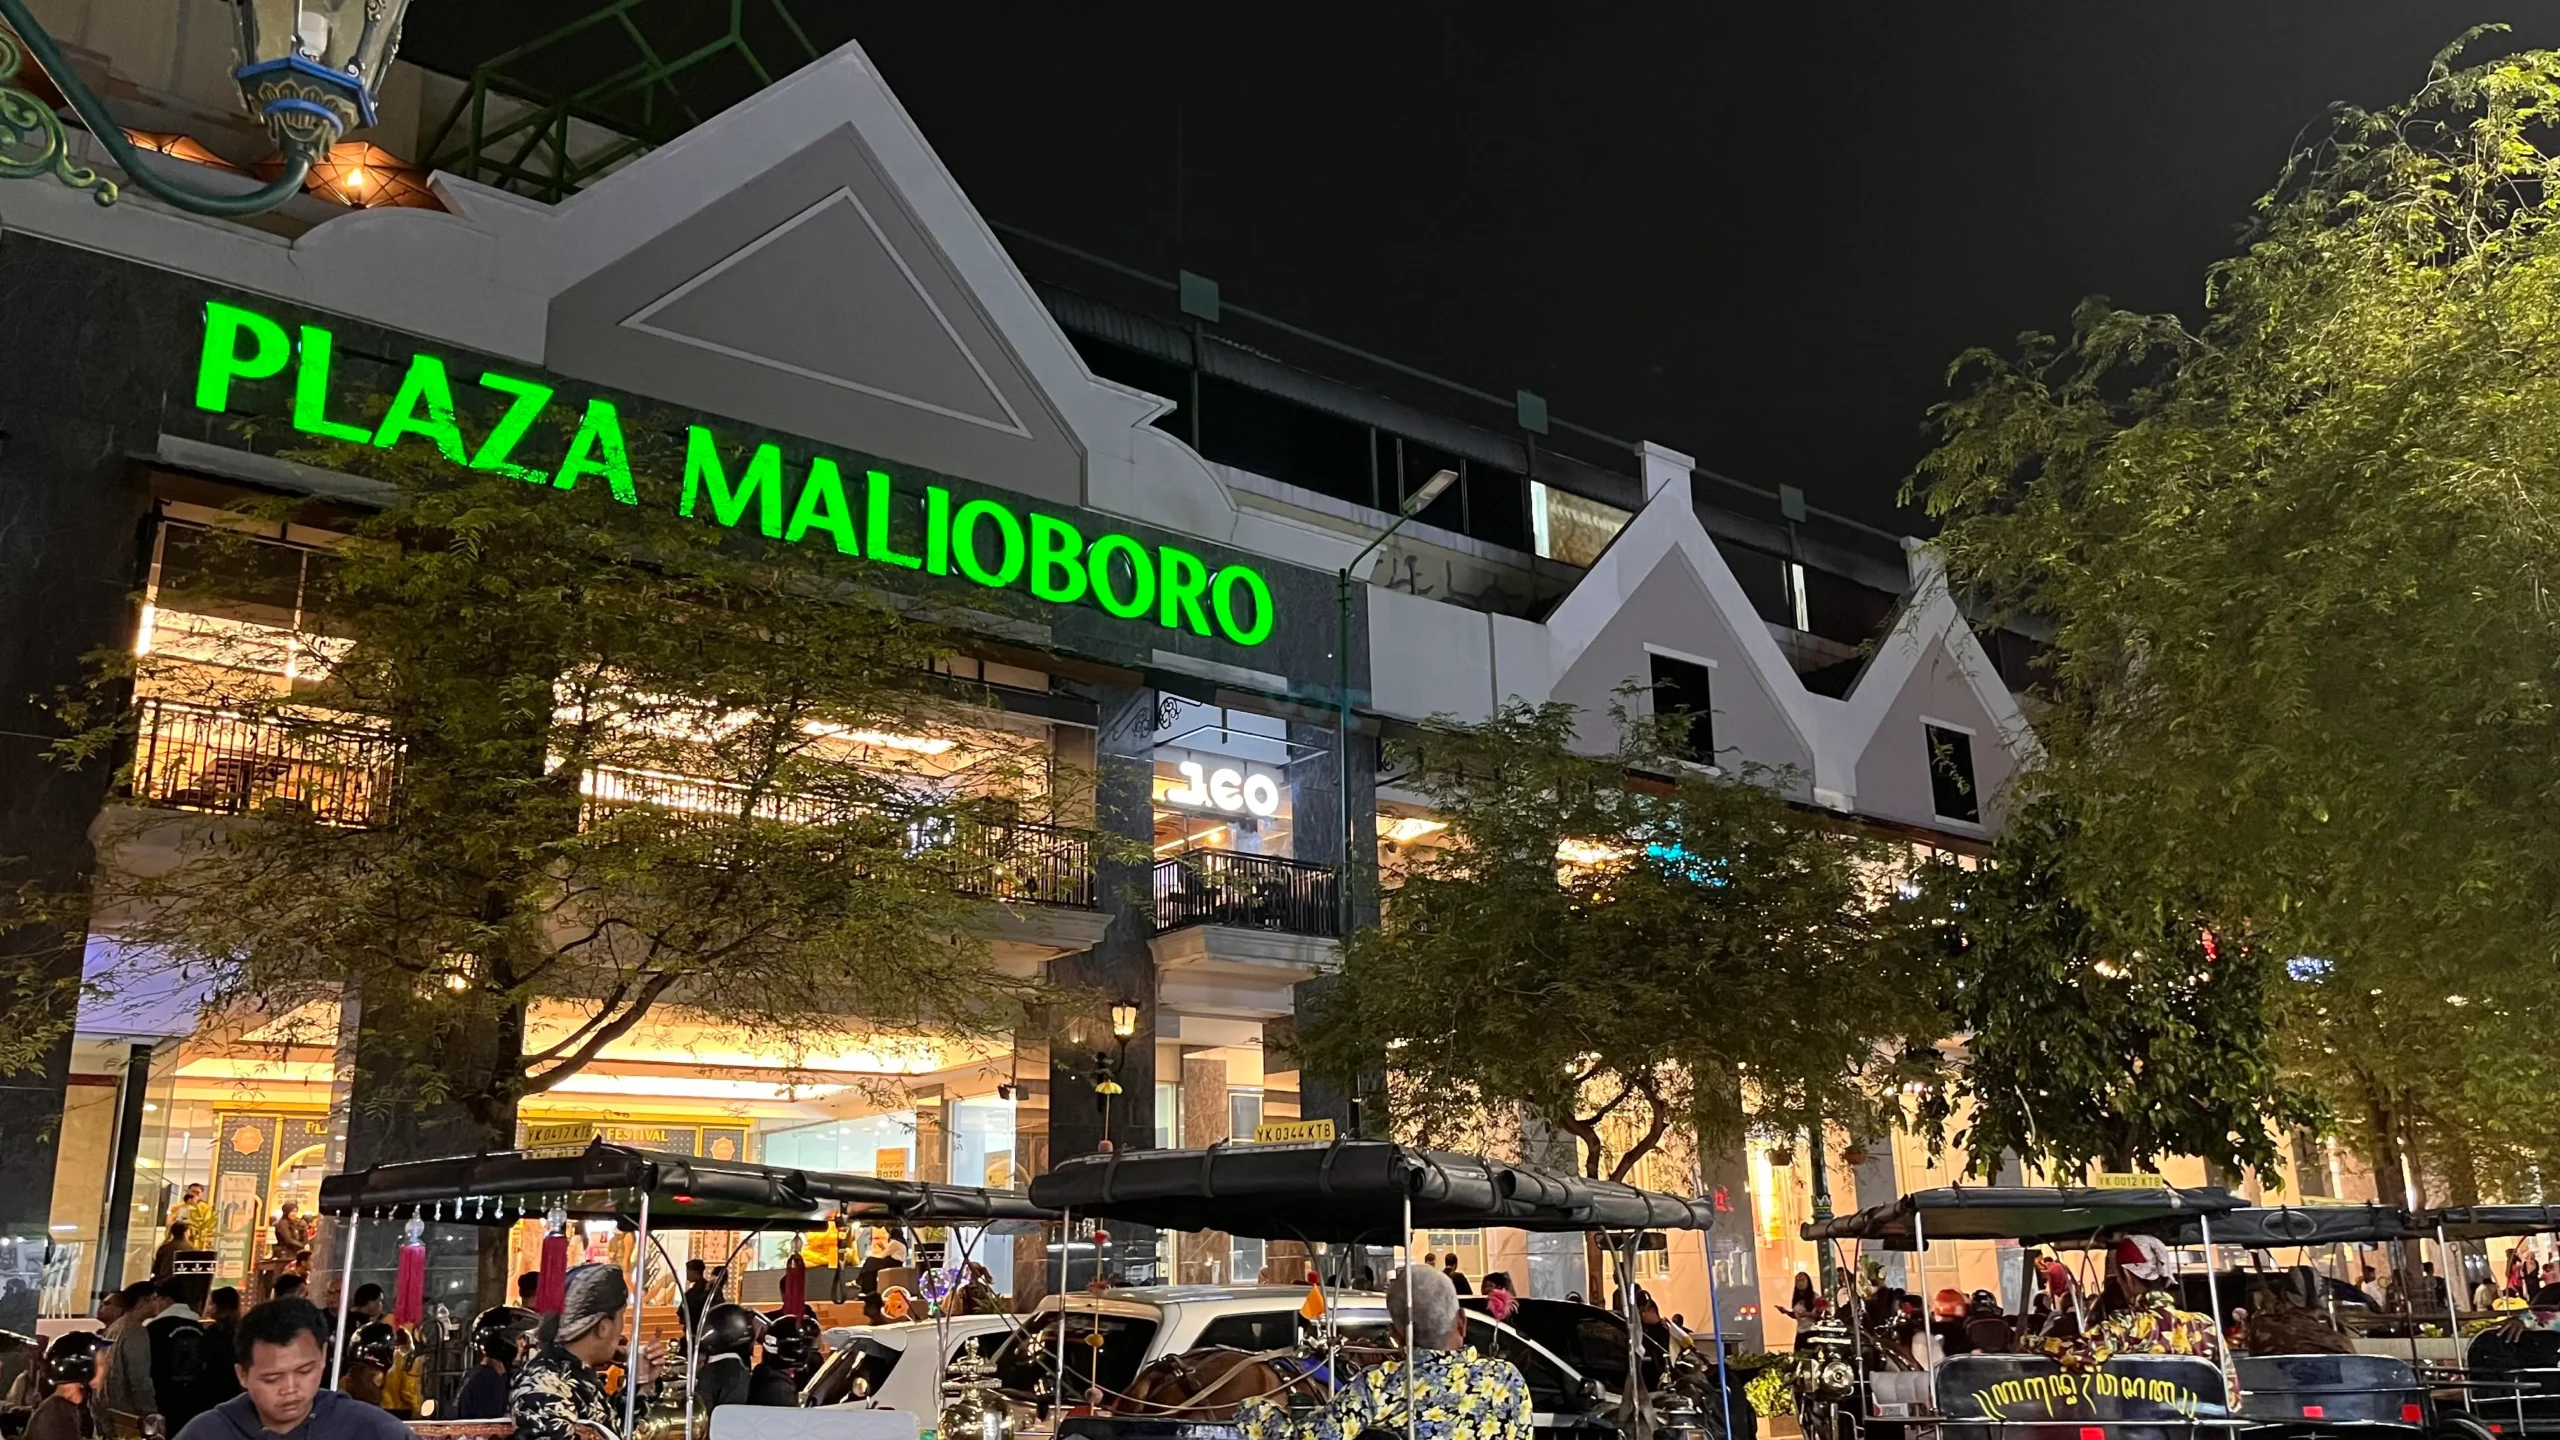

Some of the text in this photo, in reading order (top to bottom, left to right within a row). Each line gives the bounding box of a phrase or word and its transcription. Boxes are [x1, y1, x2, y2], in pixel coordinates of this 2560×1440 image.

[196, 301, 1275, 646] PLAZA MALIOBORO
[528, 1129, 543, 1142] YK
[543, 1127, 571, 1141] 0417
[606, 1128, 669, 1142] FESTIVAL
[1256, 1123, 1331, 1142] YK 0344 KTB
[876, 1169, 904, 1179] Bazar
